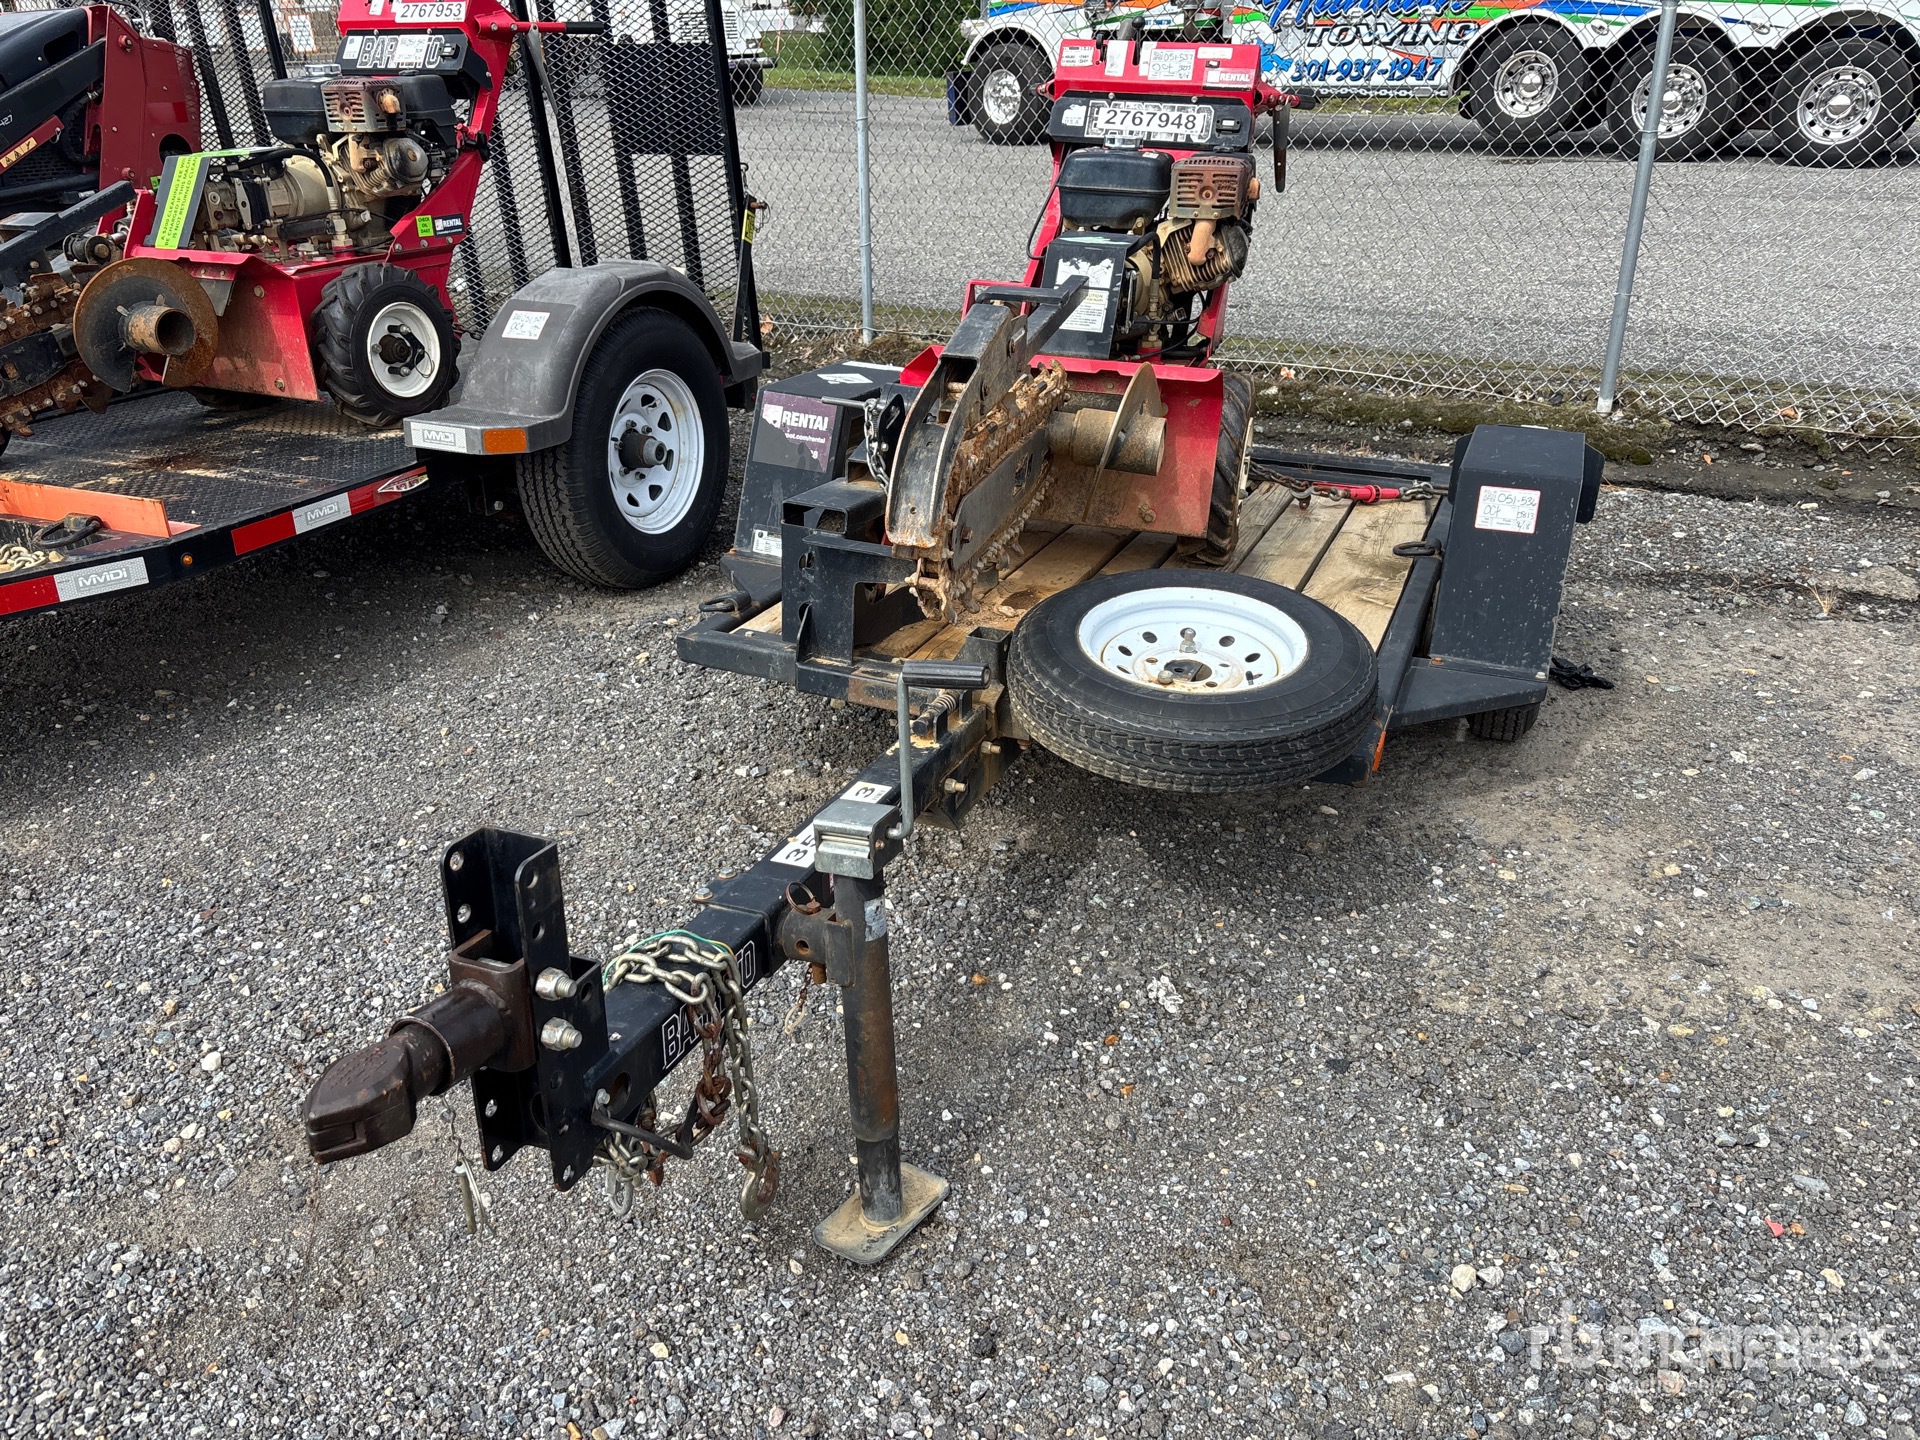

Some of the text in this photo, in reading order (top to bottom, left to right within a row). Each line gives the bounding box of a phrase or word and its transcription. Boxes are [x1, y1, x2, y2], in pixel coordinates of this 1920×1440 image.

[401, 3, 462, 18] 2767953
[1306, 21, 1480, 47] TOWING
[1220, 73, 1250, 82] RENTAL
[1291, 57, 1446, 82] 301-937-1947
[1104, 109, 1197, 130] 2767948
[167, 183, 179, 217] CLEANING
[179, 180, 191, 214] RETURNED
[168, 204, 179, 235] CHARGED
[443, 218, 462, 228] RENTAL
